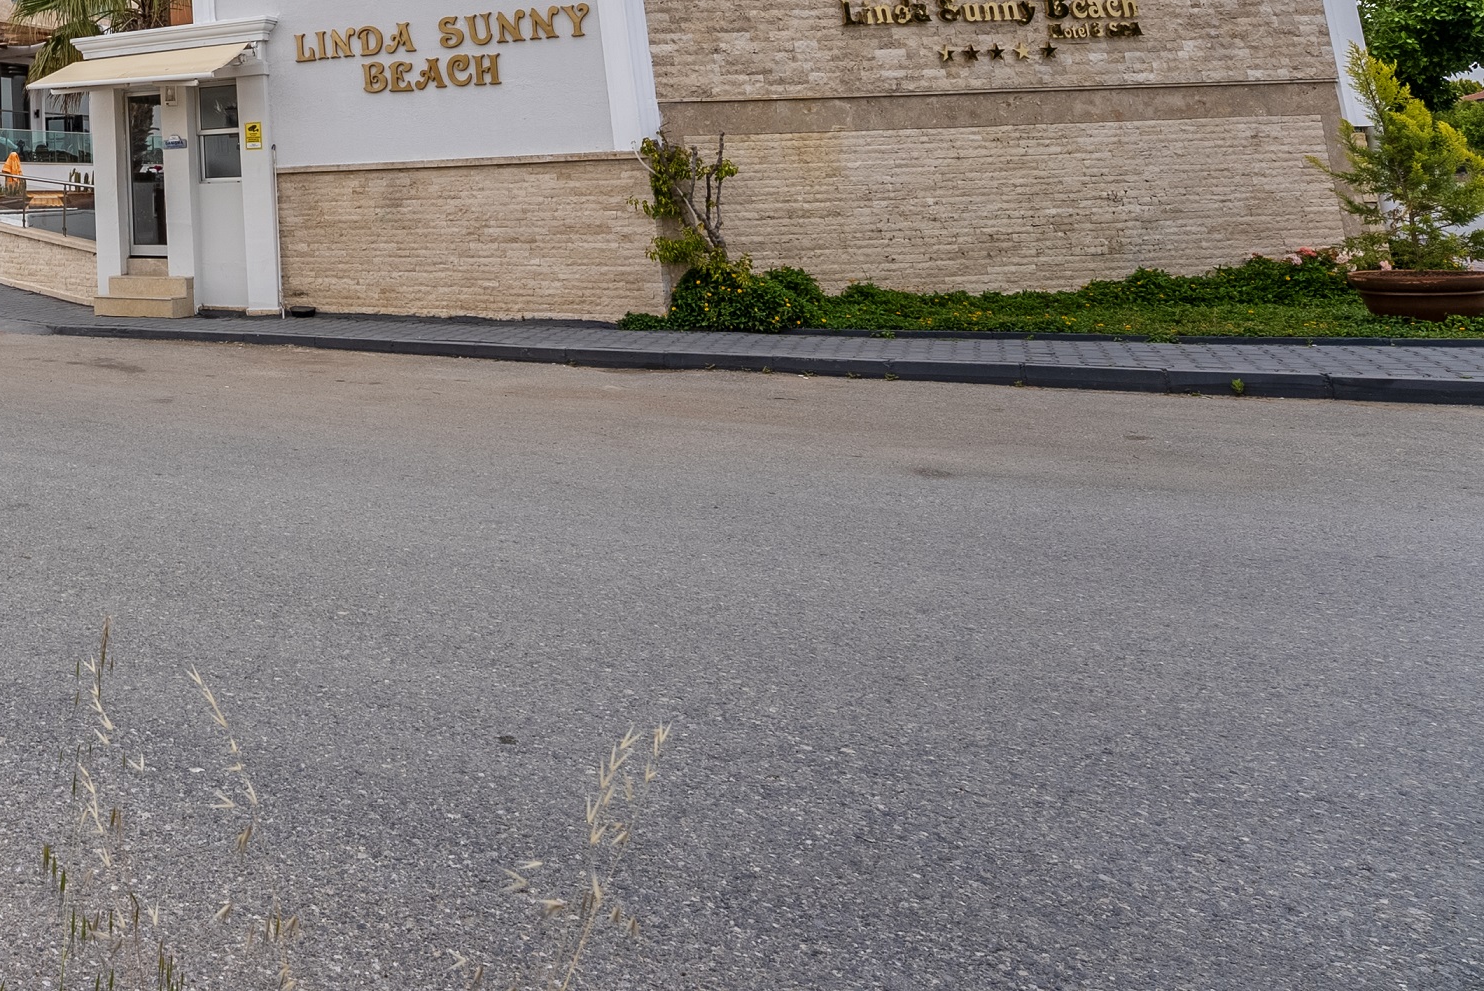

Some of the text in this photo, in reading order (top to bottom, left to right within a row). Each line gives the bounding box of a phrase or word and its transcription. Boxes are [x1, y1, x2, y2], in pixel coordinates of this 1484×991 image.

[294, 2, 590, 63] LINDA SUNNY
[361, 52, 503, 94] BEACH
